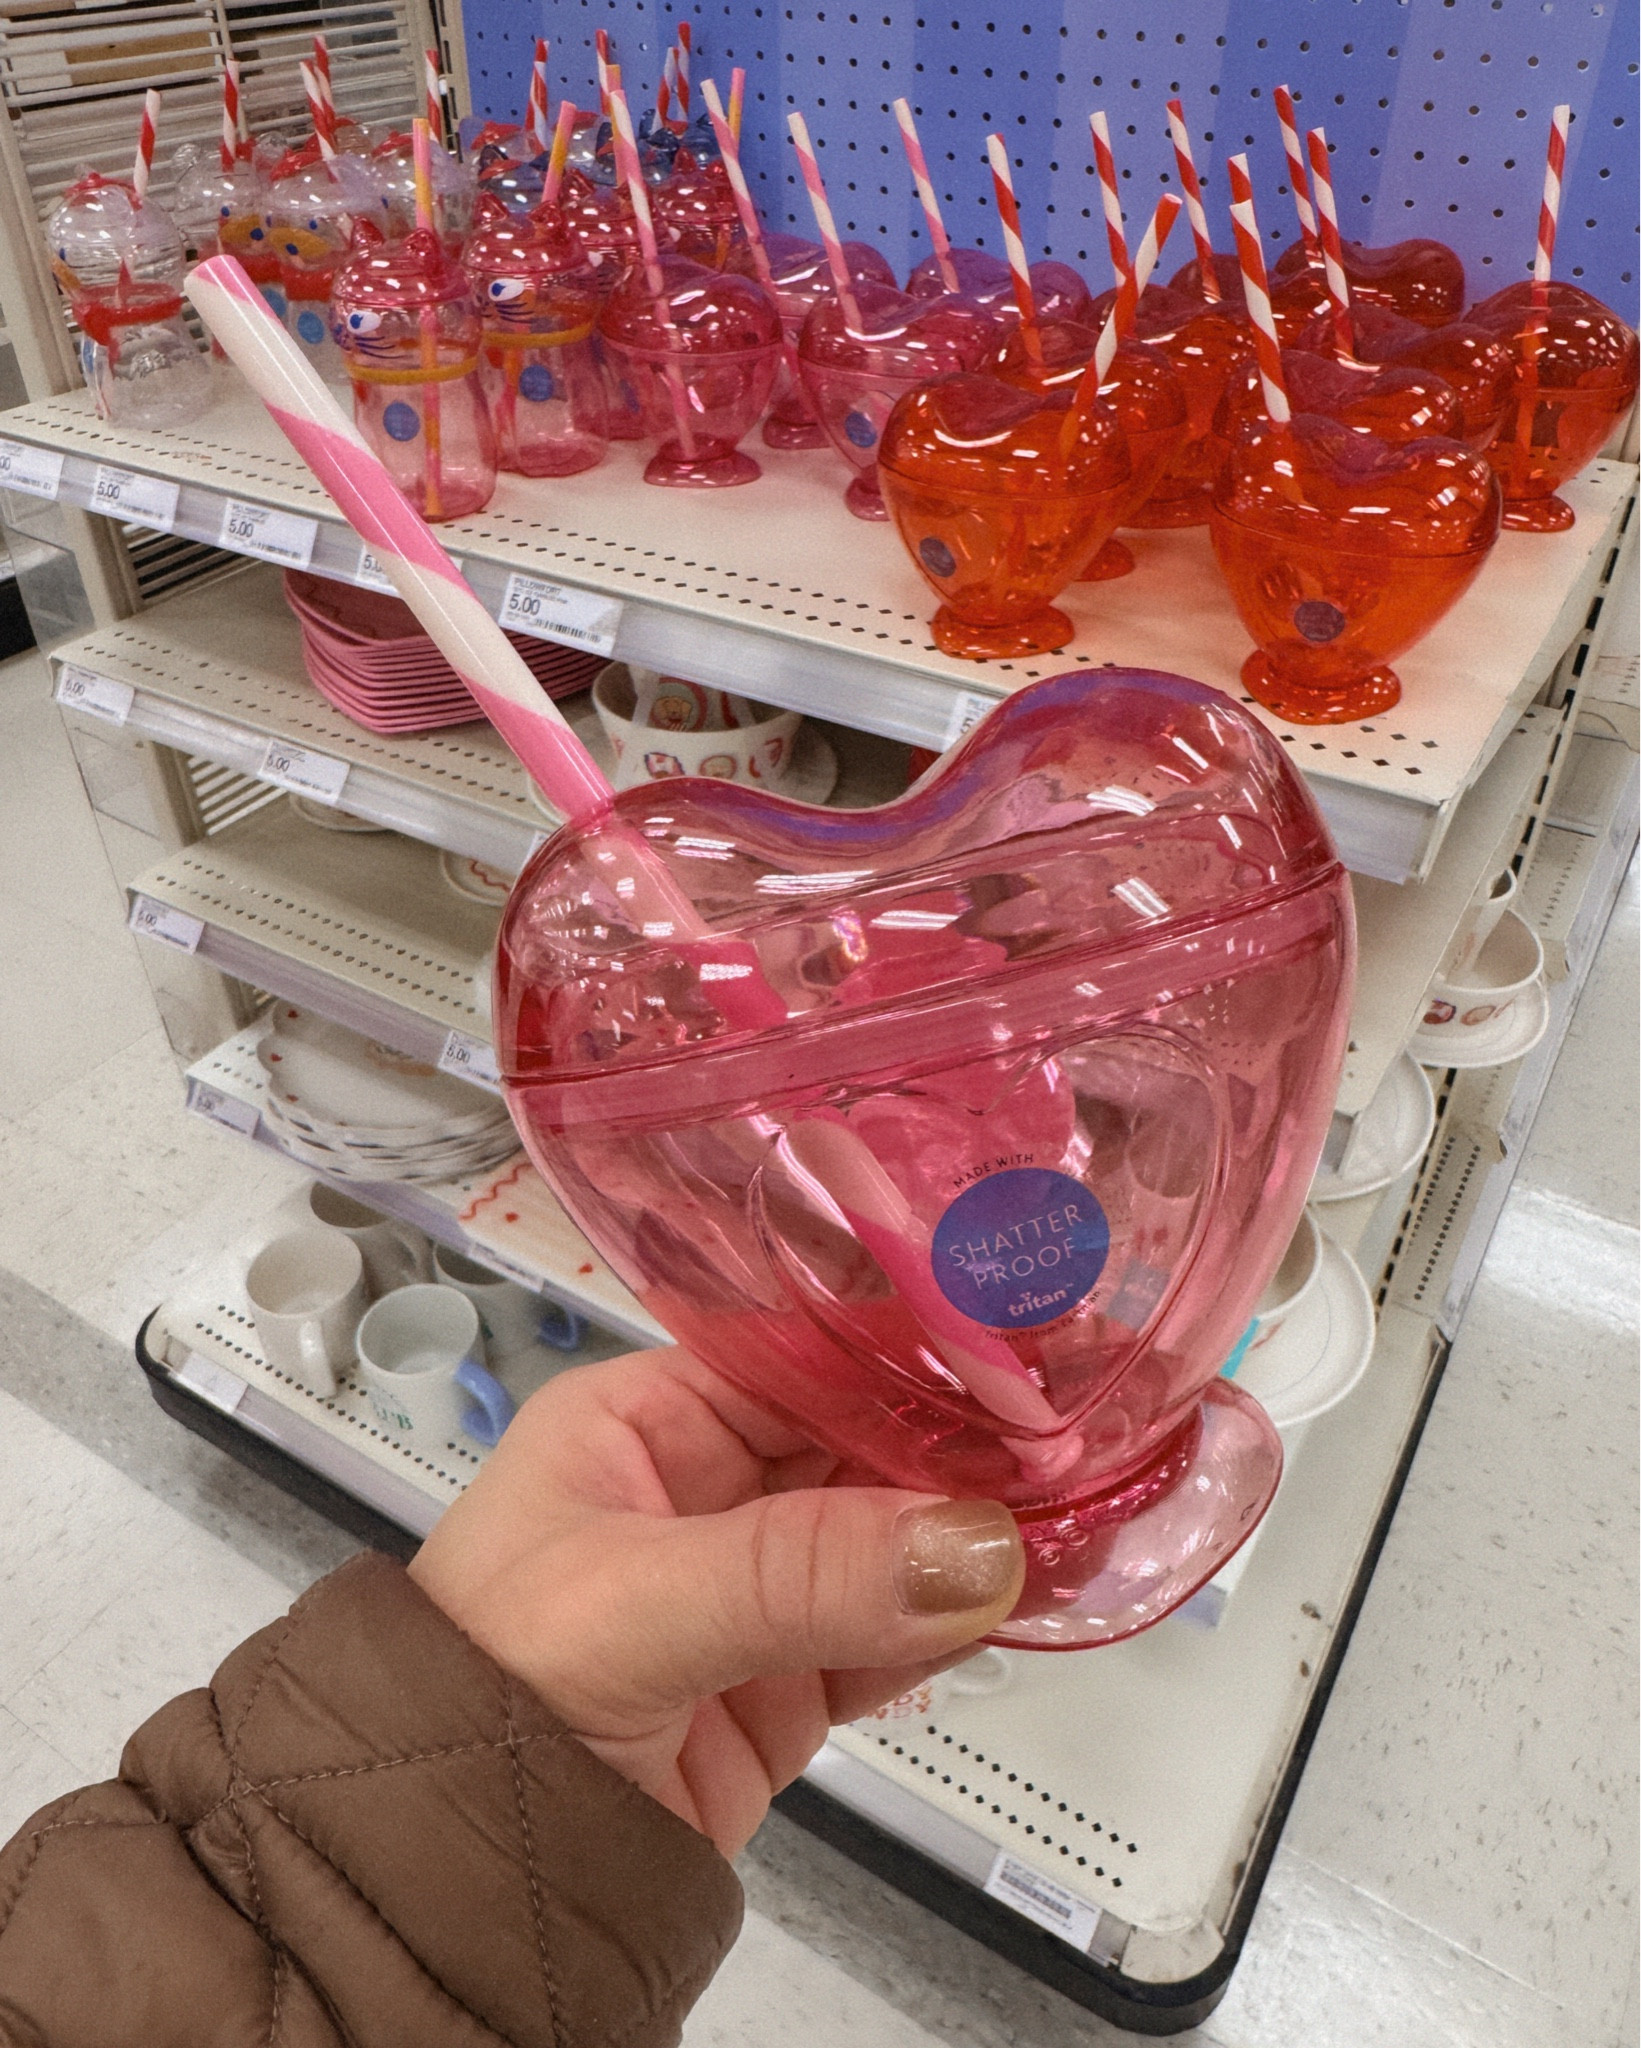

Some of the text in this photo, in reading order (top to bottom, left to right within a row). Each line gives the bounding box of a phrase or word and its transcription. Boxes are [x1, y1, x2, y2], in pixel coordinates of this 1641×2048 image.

[97, 481, 120, 499] 5.00
[229, 519, 254, 538] 5.00
[509, 593, 541, 616] 5.00
[953, 1153, 1034, 1188] MADE WITH
[949, 1204, 1083, 1267] SHATTER
[972, 1237, 1076, 1290] PROOF
